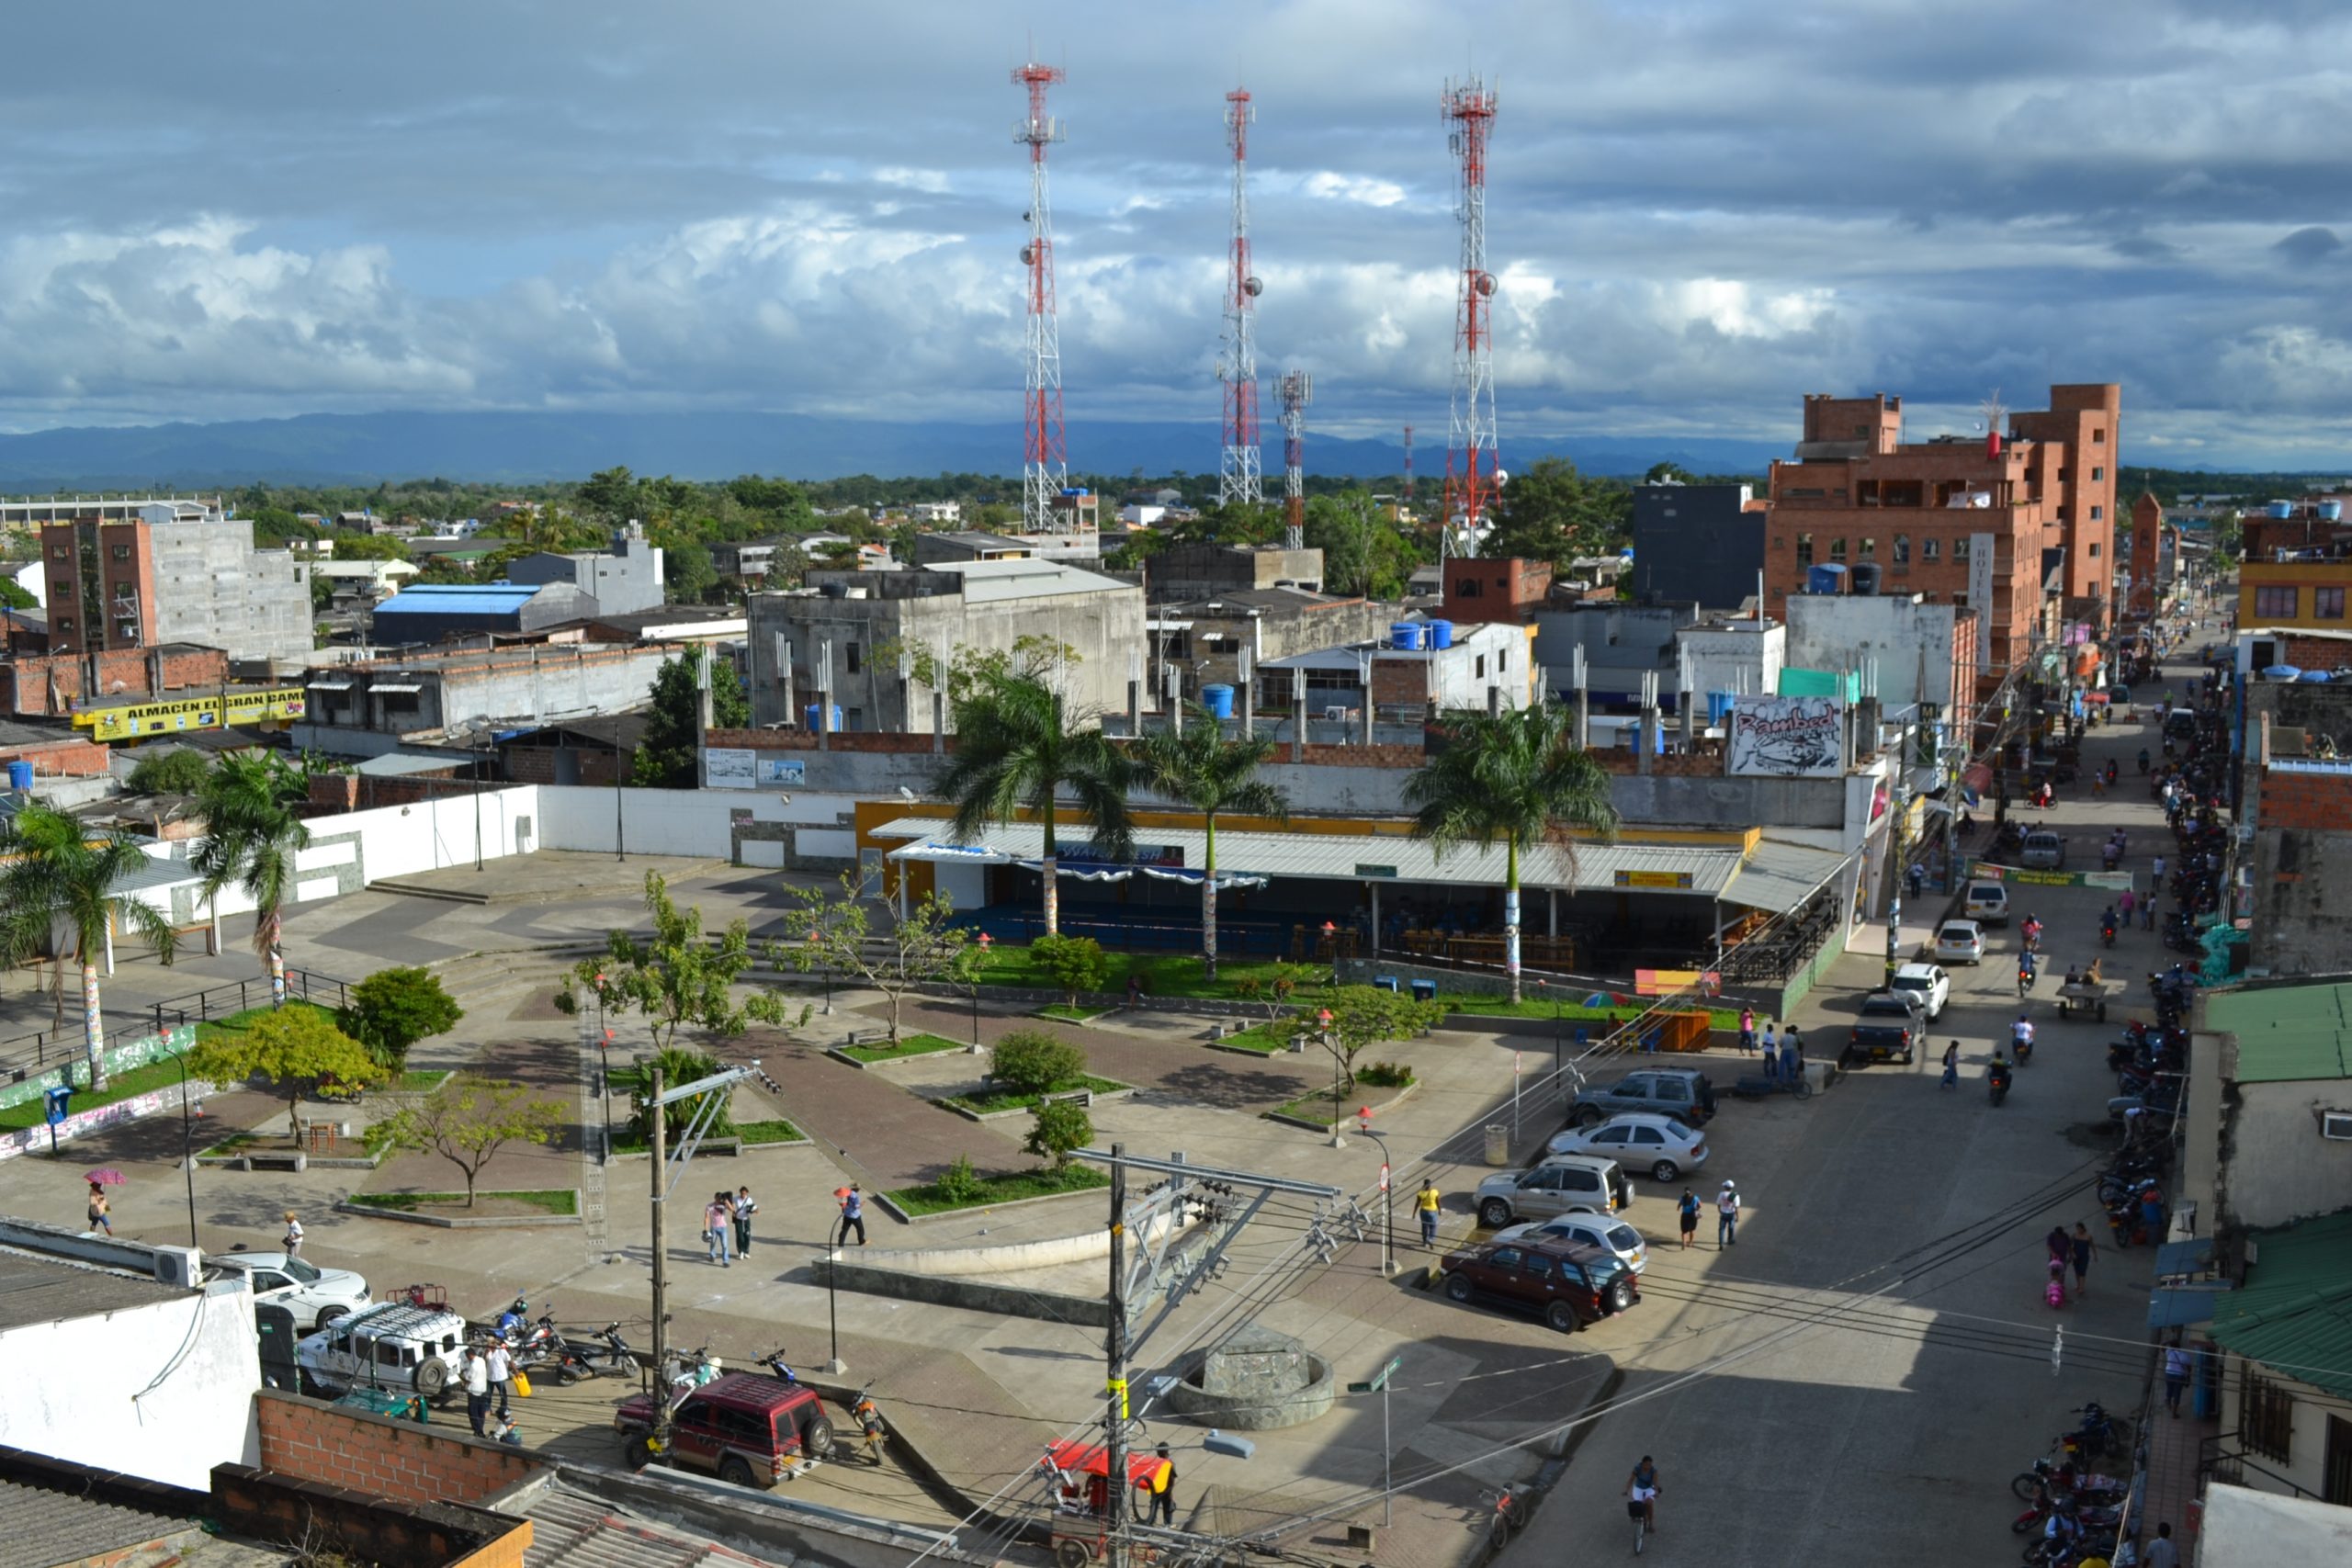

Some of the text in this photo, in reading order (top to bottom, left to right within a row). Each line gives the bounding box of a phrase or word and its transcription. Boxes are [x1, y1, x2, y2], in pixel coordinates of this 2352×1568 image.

[1976, 548, 1987, 600] HOTEL
[128, 701, 200, 719] ALMACÉN
[204, 698, 220, 711] EL
